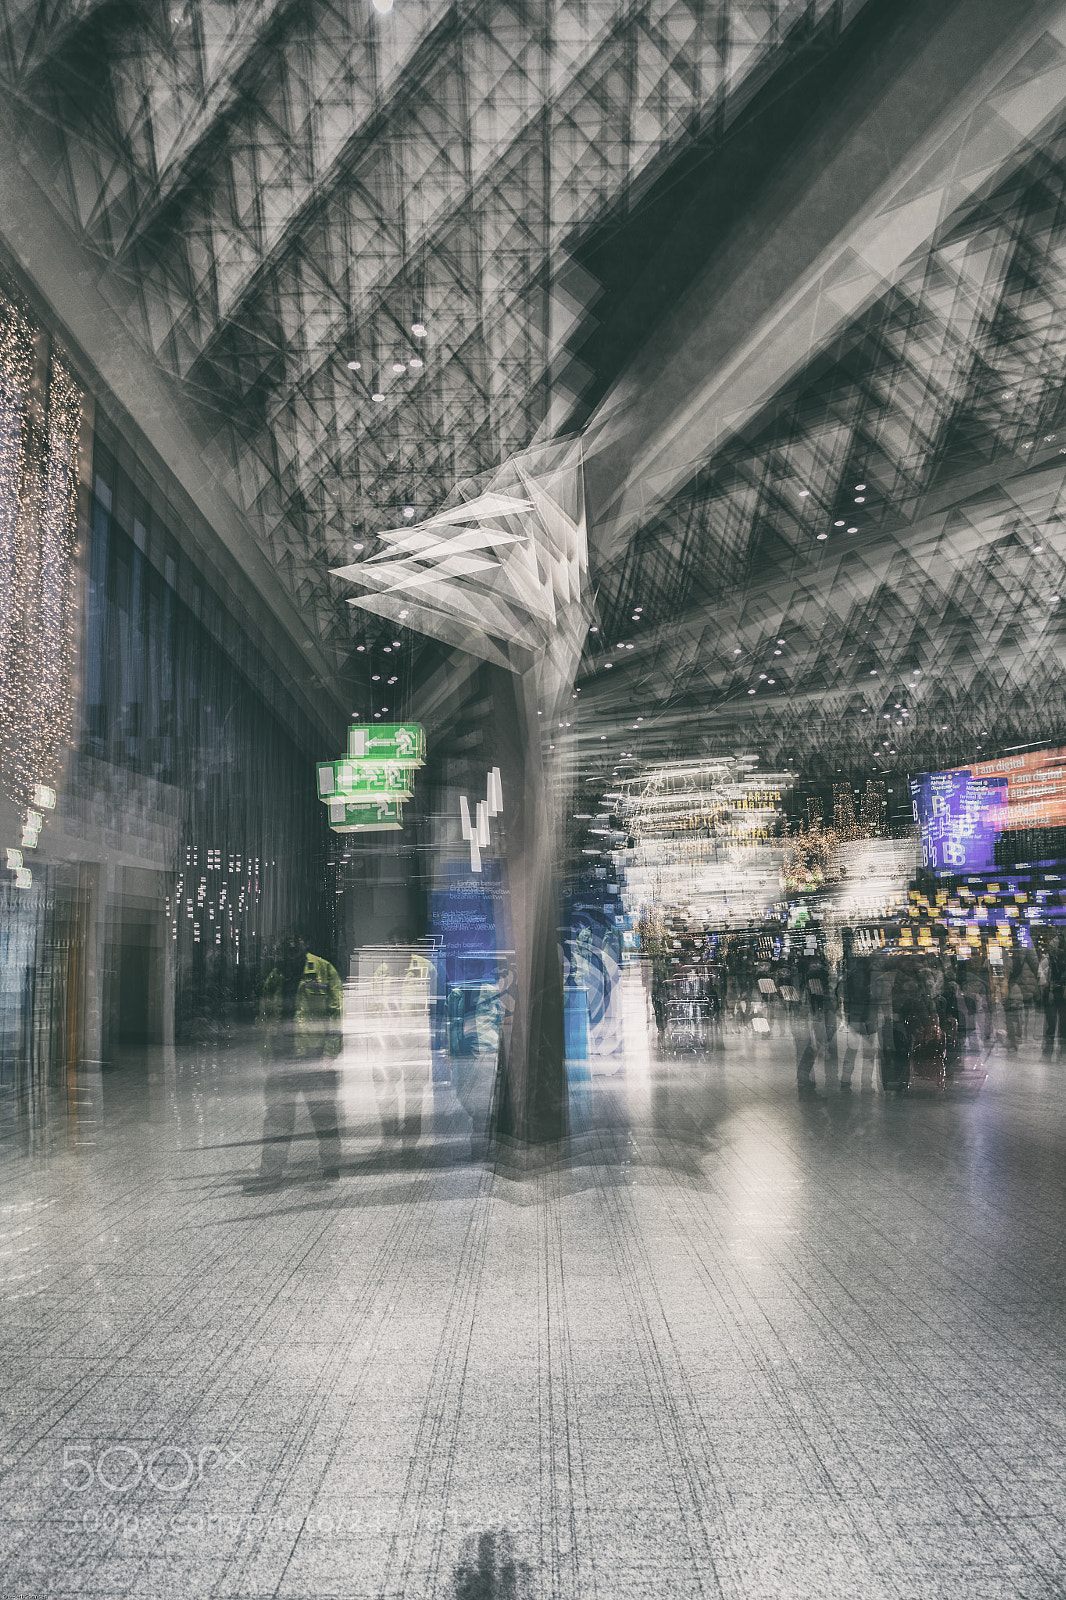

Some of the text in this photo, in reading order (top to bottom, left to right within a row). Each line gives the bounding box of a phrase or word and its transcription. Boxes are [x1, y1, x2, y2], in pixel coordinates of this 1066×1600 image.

[980, 766, 994, 774] am
[996, 756, 1025, 772] digital
[1016, 774, 1031, 783] am
[1033, 768, 1063, 782] digital
[1011, 788, 1025, 797] am
